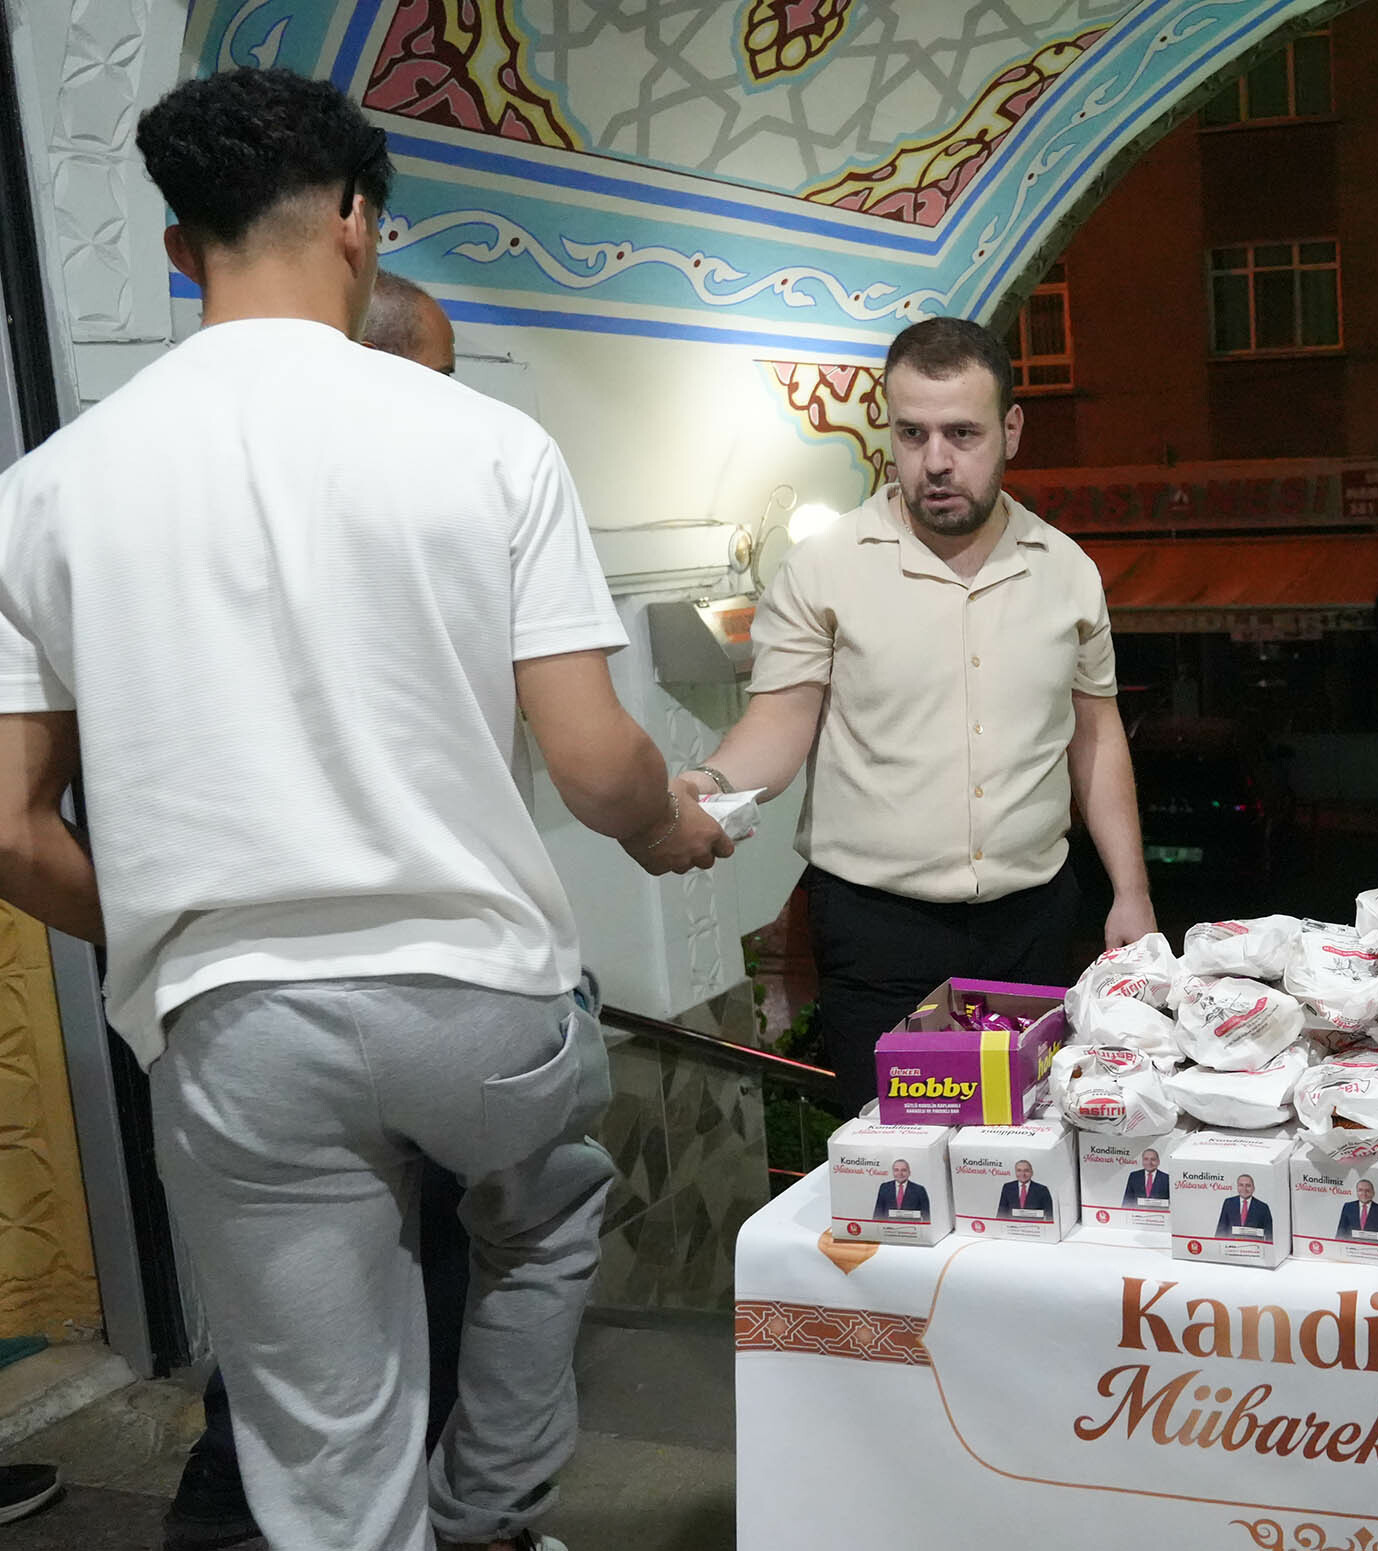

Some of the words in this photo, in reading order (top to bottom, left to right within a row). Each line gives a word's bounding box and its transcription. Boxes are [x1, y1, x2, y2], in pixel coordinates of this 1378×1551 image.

[888, 1077, 978, 1100] hobby
[1090, 1146, 1130, 1156] Kandilimiz
[840, 1157, 881, 1167] Kandilimiz
[962, 1158, 1003, 1168] Kandilimiz
[1115, 1156, 1138, 1166] Olsun
[1183, 1172, 1225, 1182] Kandilimiz
[1302, 1176, 1344, 1186] Kandilimiz
[1209, 1182, 1233, 1192] Olsun
